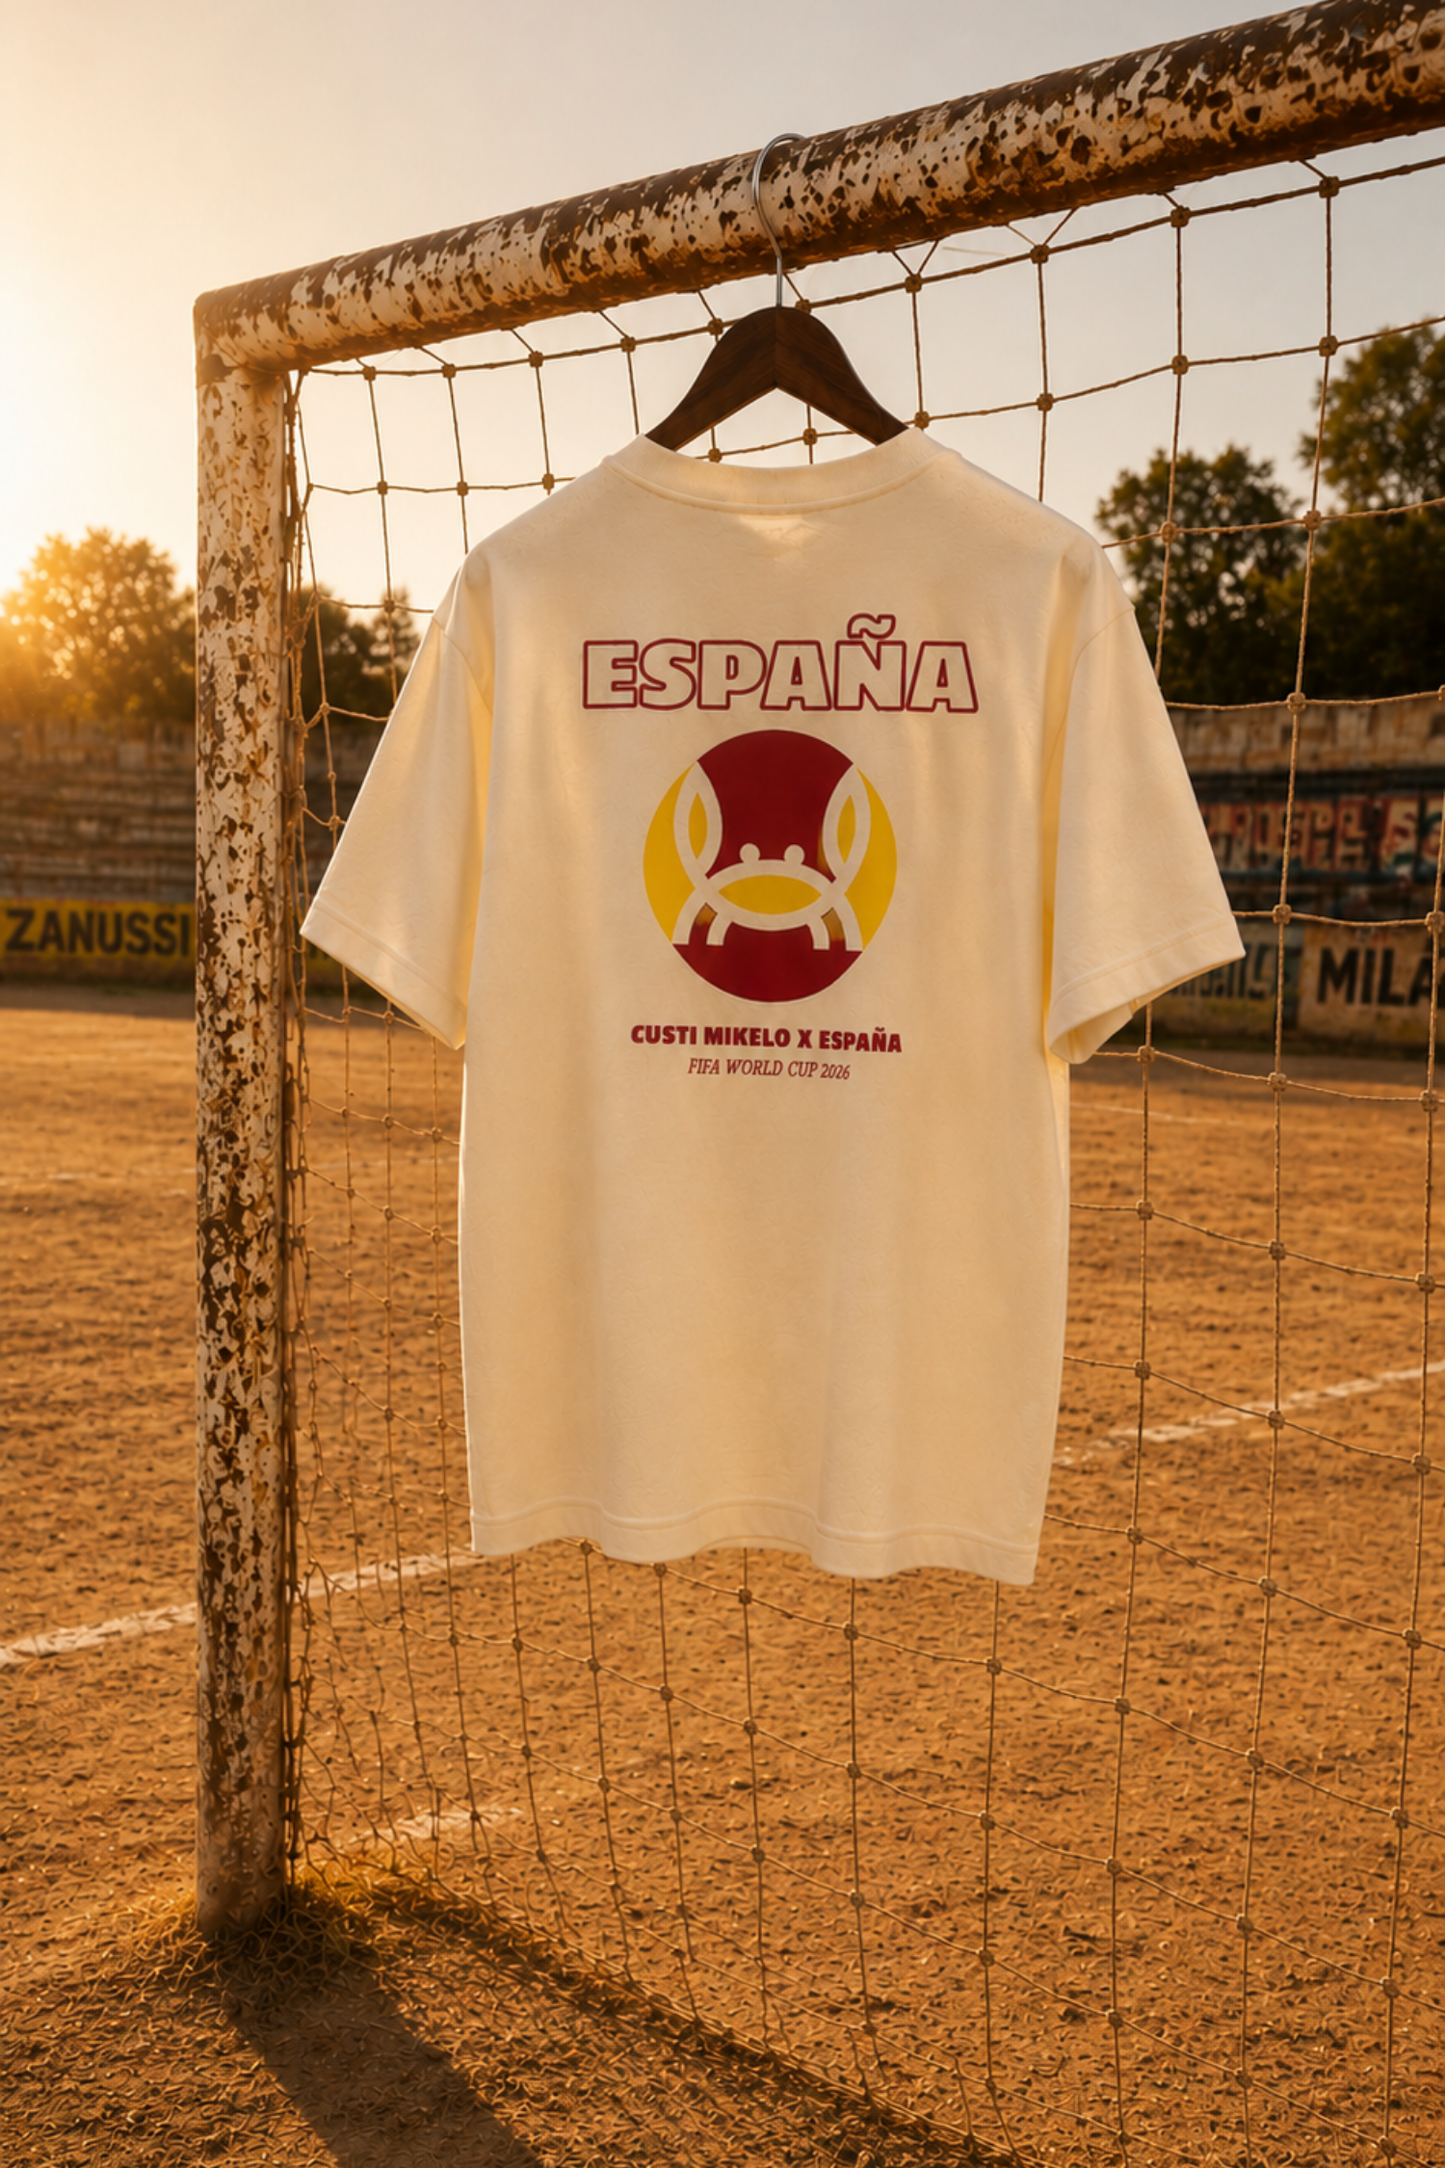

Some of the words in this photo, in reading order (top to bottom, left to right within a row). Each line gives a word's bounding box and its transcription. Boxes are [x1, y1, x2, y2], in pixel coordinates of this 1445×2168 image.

[582, 612, 979, 714] ESPAÑA
[4, 907, 190, 956] ZANUSSI
[630, 1024, 698, 1046] CUSTI
[703, 1026, 792, 1048] MIKELO
[796, 1028, 813, 1050] X
[818, 1026, 903, 1053] ESPAÑA
[687, 1057, 720, 1075] FIFA
[725, 1058, 784, 1077] WORLD
[786, 1060, 819, 1078] CUP
[820, 1062, 851, 1081] 2026
